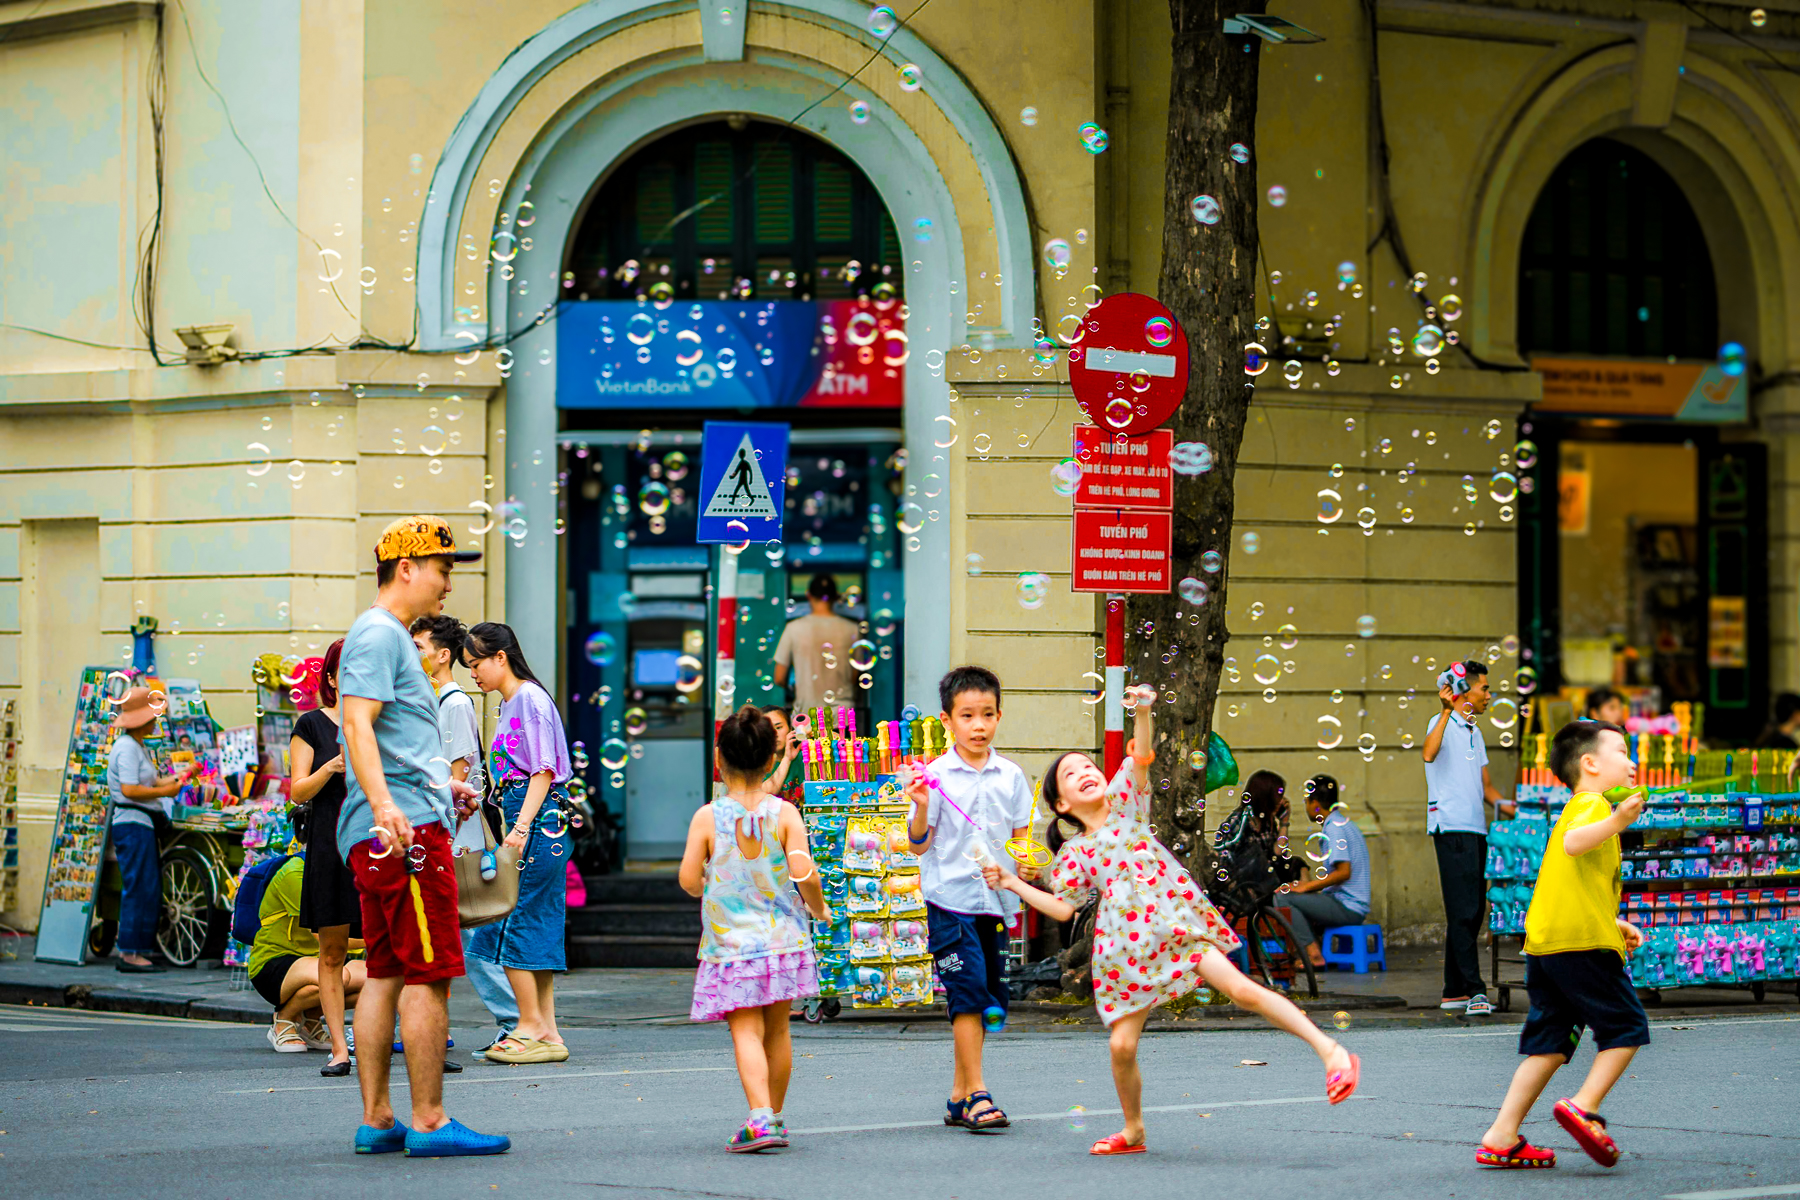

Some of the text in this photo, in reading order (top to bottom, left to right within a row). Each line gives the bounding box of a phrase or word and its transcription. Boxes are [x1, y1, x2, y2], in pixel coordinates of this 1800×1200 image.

[595, 377, 691, 394] VietinBank
[816, 373, 868, 396] ATM
[1130, 440, 1148, 456] PHỐ
[1099, 523, 1148, 539] TUYẾN PHỐ
[1080, 546, 1103, 558] KHÔNG
[1124, 548, 1140, 559] KINH
[1142, 549, 1165, 560] DOANH
[1083, 567, 1101, 580] BUÔN
[1103, 568, 1117, 580] BÁN
[1119, 568, 1136, 581] TRÊN
[1148, 568, 1162, 582] PHỐ
